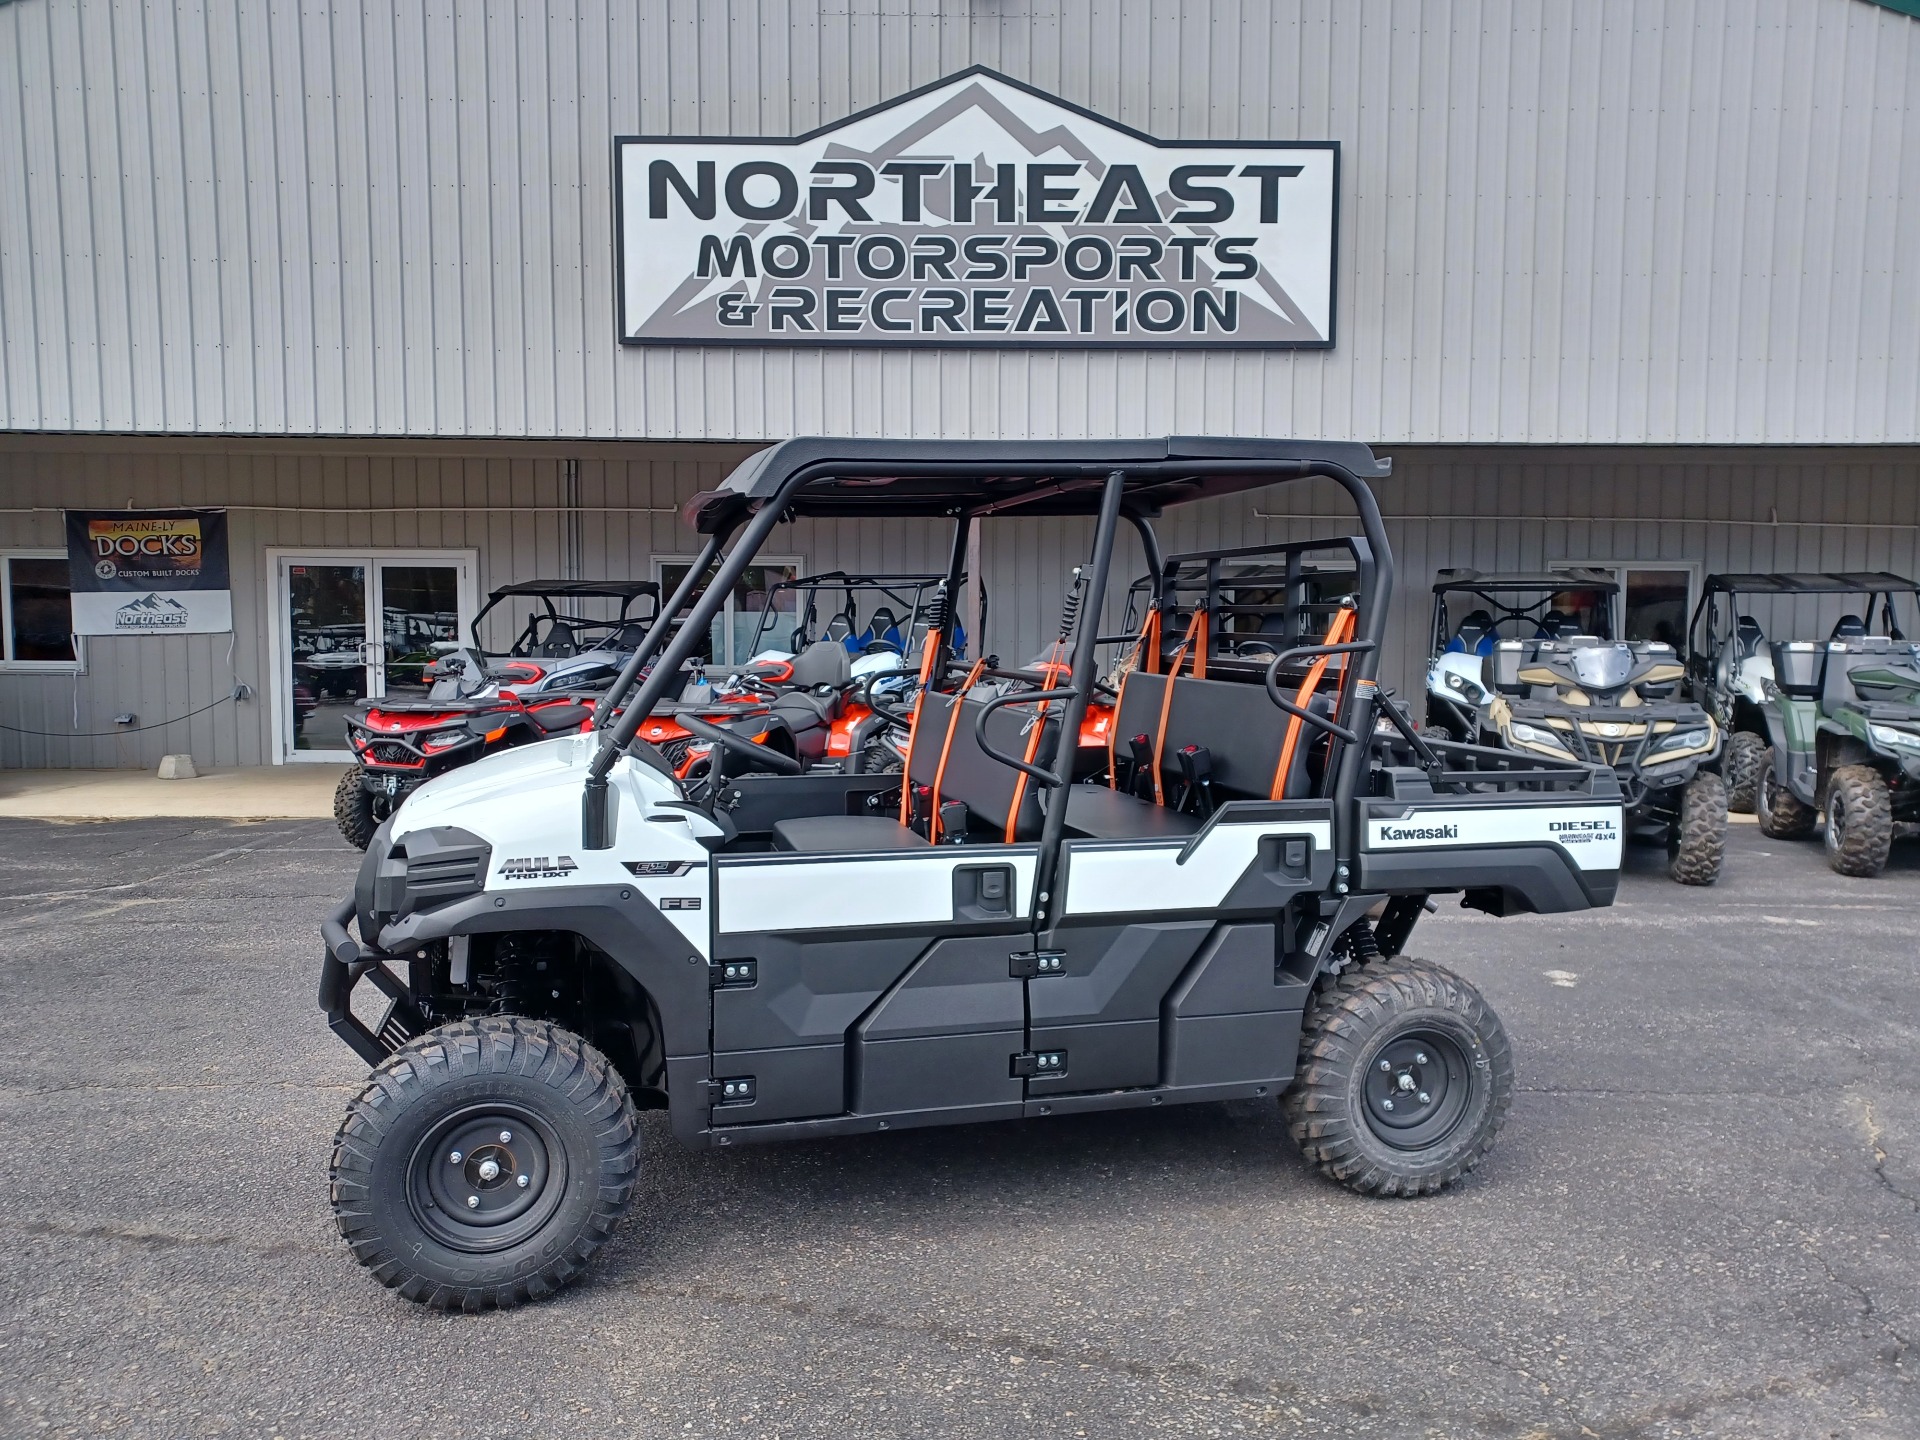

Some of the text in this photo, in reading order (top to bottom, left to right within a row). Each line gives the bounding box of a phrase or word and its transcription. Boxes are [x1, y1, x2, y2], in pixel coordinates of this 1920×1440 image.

[648, 159, 1306, 224] NORTHEAST
[696, 234, 1259, 281] MOTORSPORTS
[113, 521, 176, 532] MAINE-LY
[95, 534, 197, 557] DOCKS
[118, 569, 150, 578] CUSTOM
[152, 569, 173, 577] BUILT
[175, 568, 200, 577] DOCKS
[115, 611, 189, 625] Northeast
[1380, 824, 1458, 841] Kawasaki
[1548, 820, 1617, 832] DIESEL
[1594, 832, 1617, 841] 4x4
[497, 855, 579, 875] MULE
[505, 870, 572, 881] PRO-DXT
[661, 898, 701, 909] FE
